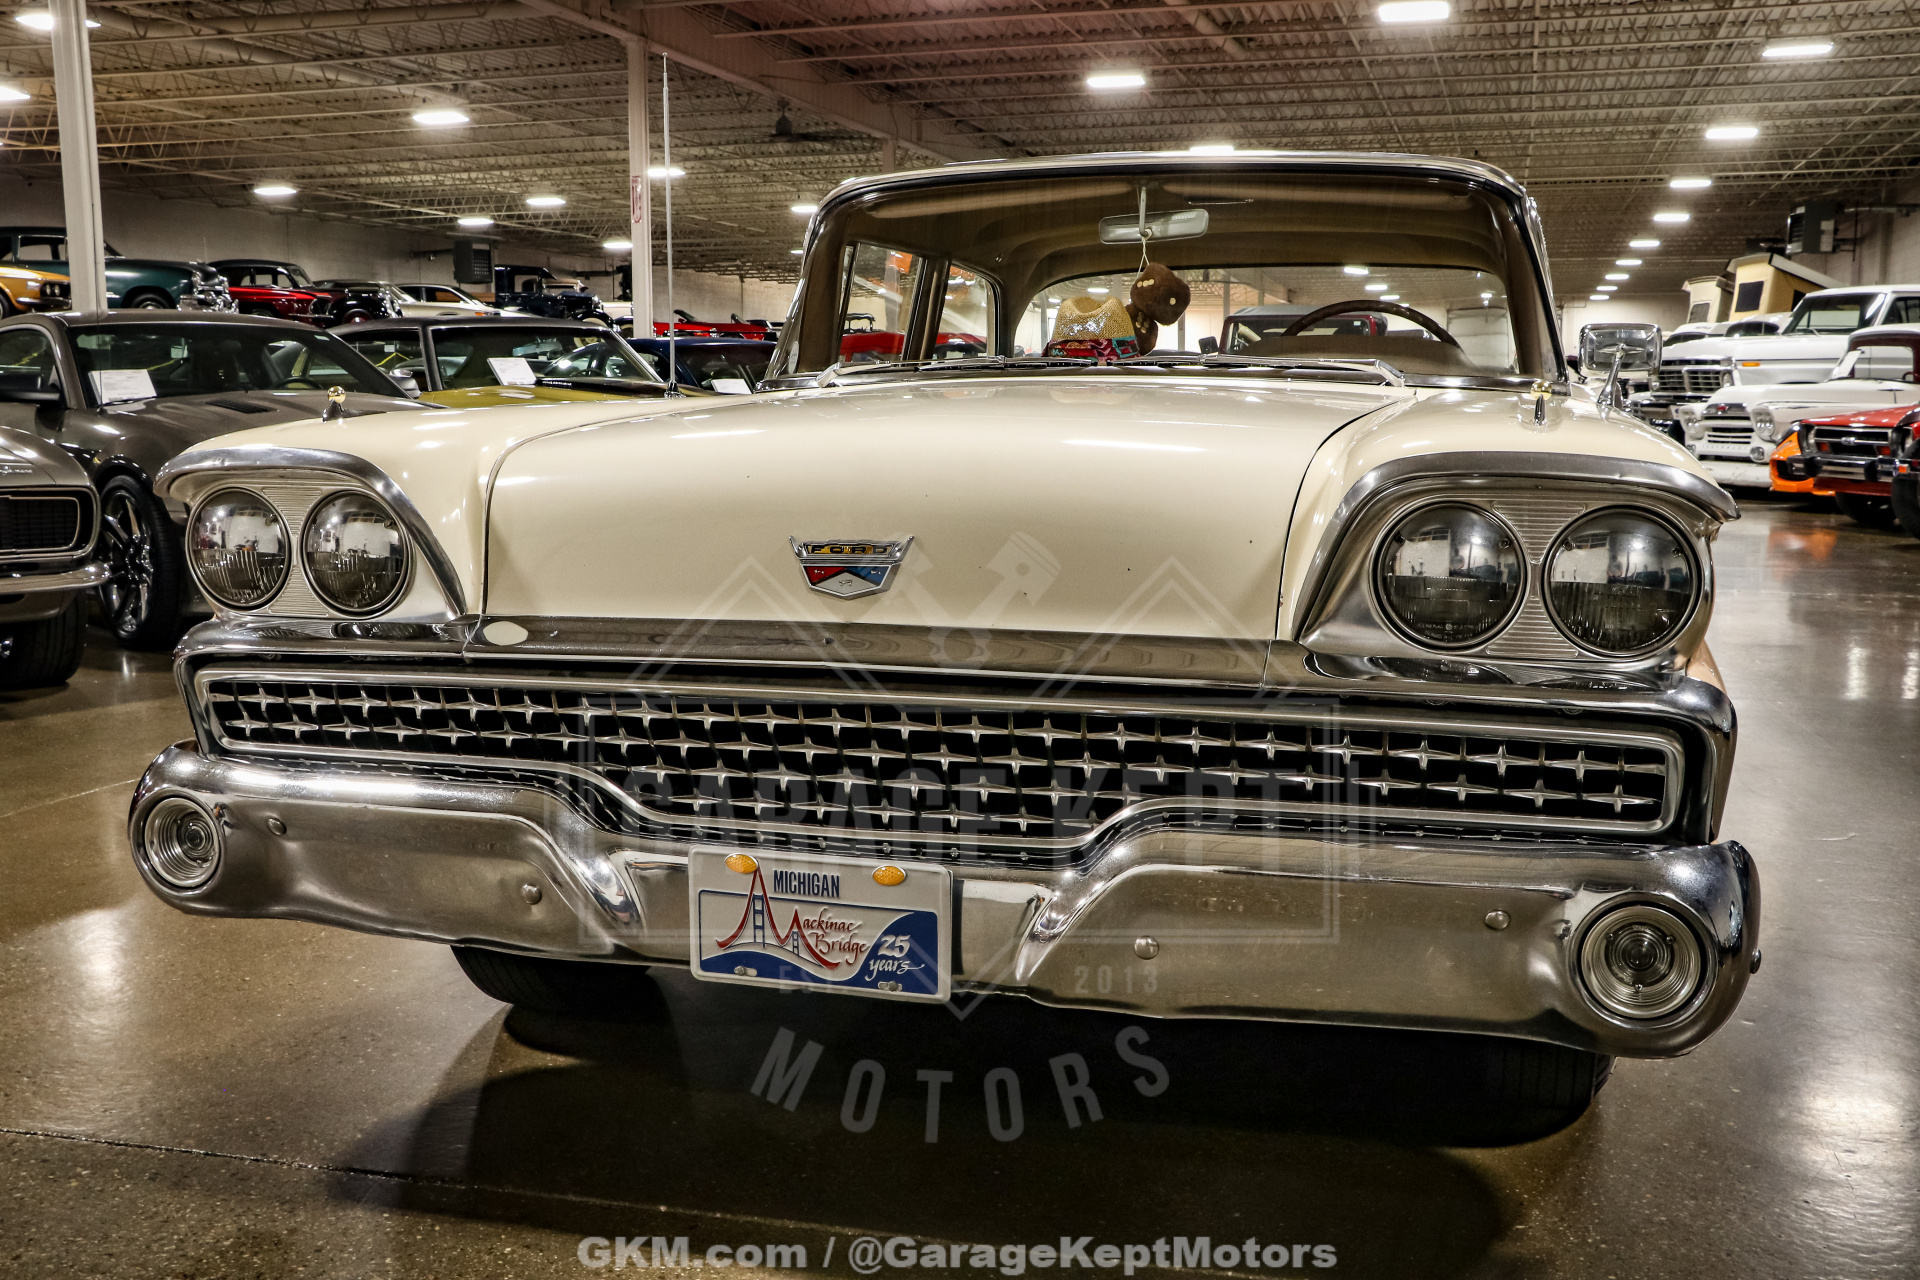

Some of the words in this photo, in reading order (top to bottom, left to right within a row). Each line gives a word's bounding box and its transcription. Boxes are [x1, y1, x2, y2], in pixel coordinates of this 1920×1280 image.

[810, 545, 888, 555] FORD
[773, 868, 841, 898] MICHIGAN
[811, 932, 870, 966] Bridge
[877, 934, 911, 958] 25
[864, 956, 925, 981] years
